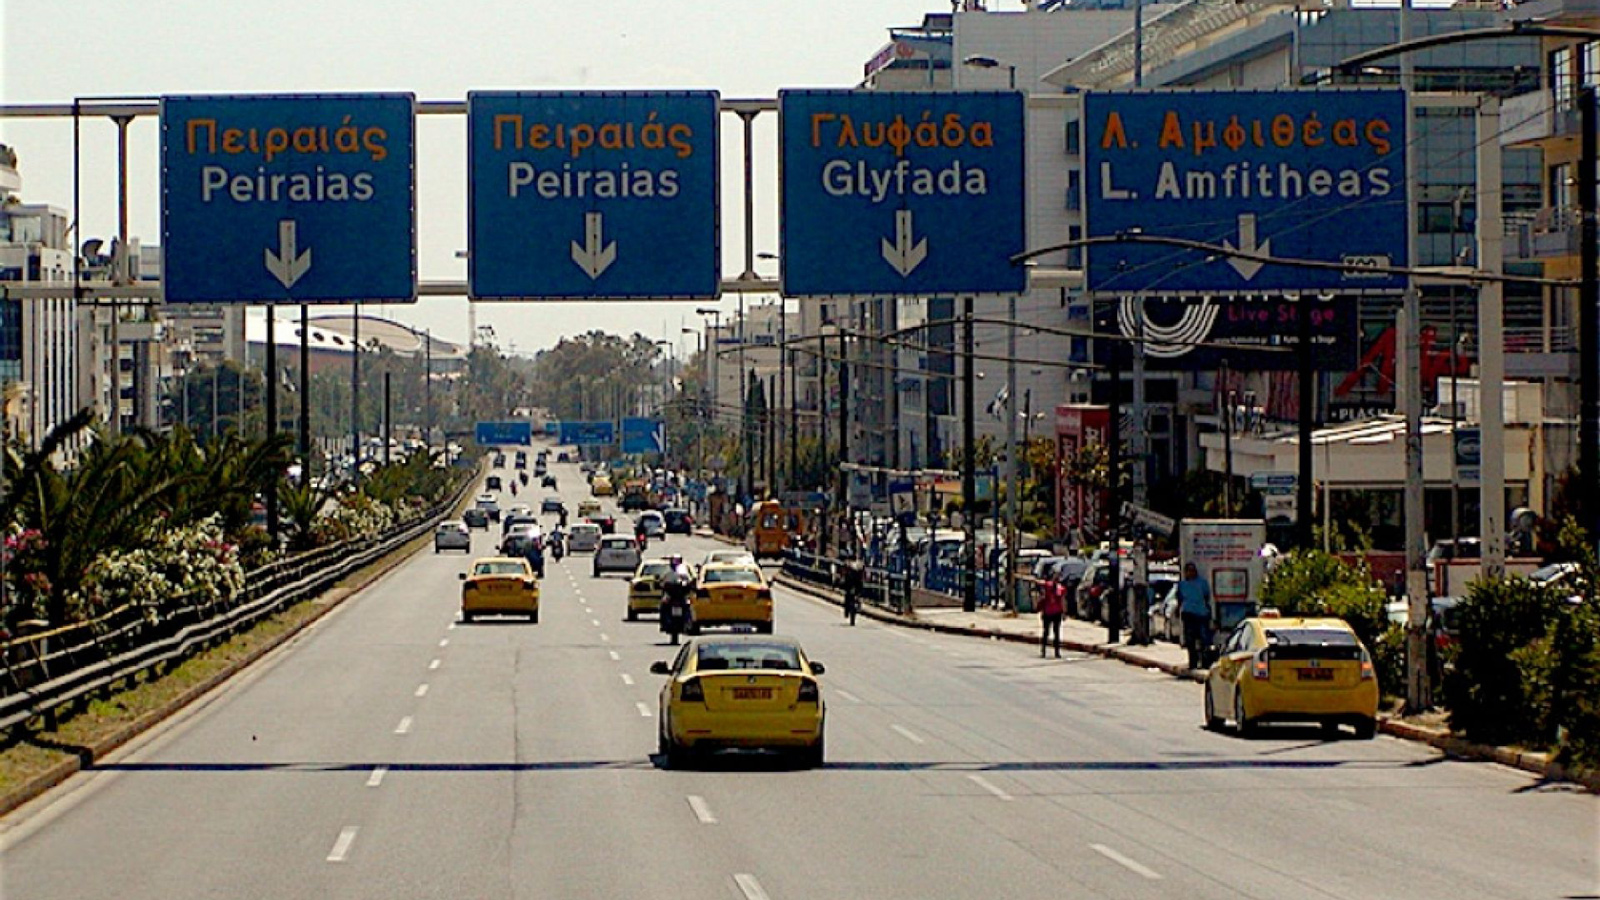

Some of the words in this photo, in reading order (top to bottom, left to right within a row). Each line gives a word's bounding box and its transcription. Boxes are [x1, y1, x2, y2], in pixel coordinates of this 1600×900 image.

[186, 114, 388, 163] Πειραιάς
[493, 110, 693, 159] Πειραιάς
[810, 109, 994, 157] Γλυφάδα
[1101, 111, 1138, 148] Λ.
[1158, 109, 1391, 155] Αμφιθέας
[202, 164, 374, 202] Peiraias
[508, 161, 680, 199] Peiraias
[822, 159, 987, 203] Glyfada
[1101, 161, 1138, 199] L.
[1154, 161, 1391, 199] Amfitheas
[1226, 303, 1270, 322] Live
[1276, 303, 1336, 327] Stge
